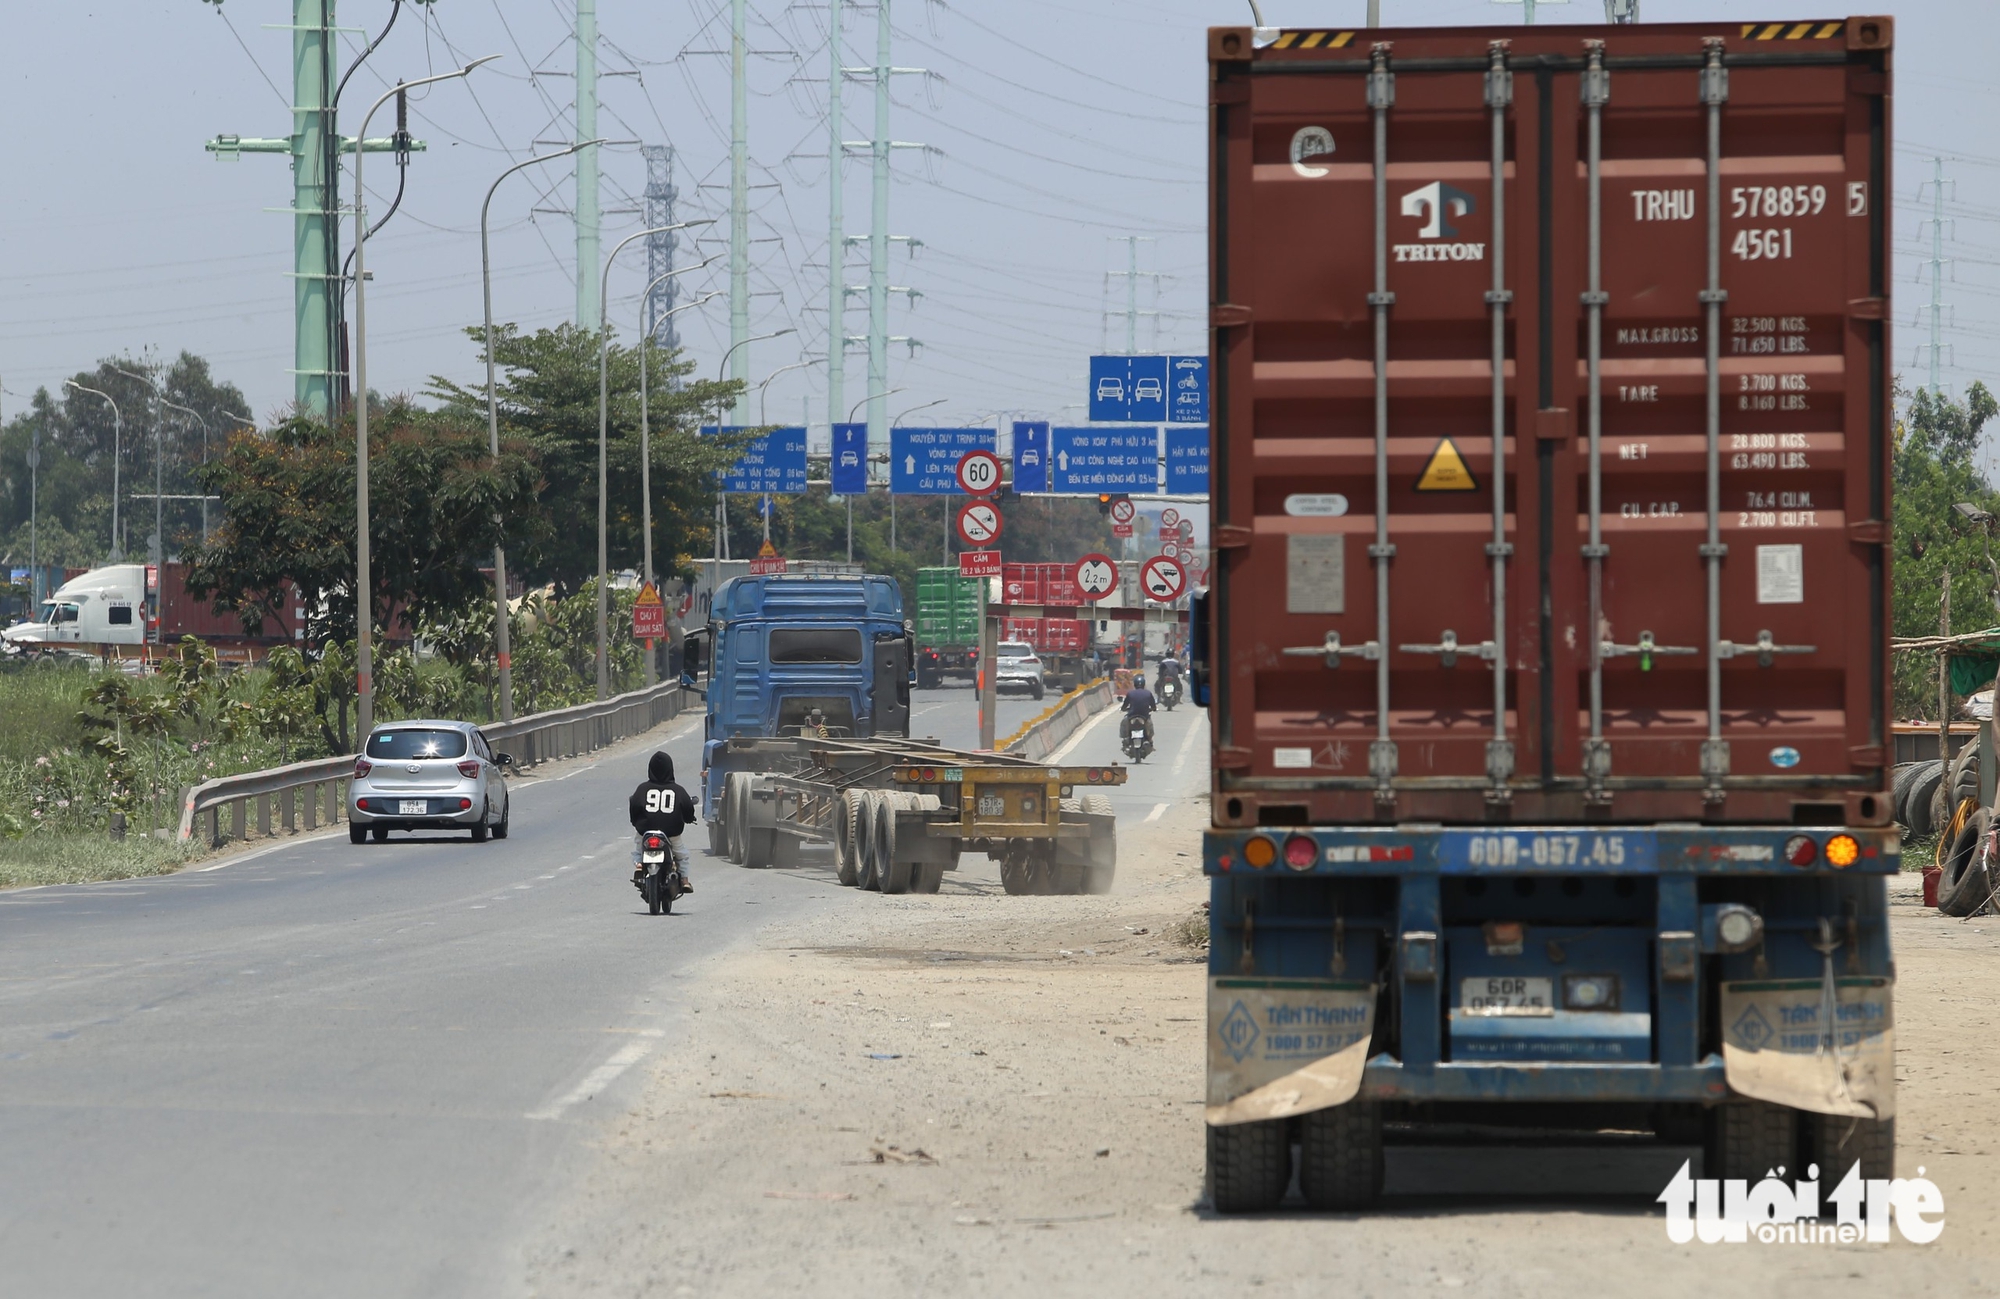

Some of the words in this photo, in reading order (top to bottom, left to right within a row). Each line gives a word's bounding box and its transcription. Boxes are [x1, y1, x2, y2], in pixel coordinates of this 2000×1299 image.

[1632, 188, 1695, 222] TRHU
[1730, 183, 1827, 217] 578859
[1847, 181, 1868, 217] 5
[1393, 243, 1486, 262] TRITON
[1732, 229, 1793, 260] 45G1
[1732, 317, 1776, 333] 32.500
[1617, 327, 1699, 345] MAX.GROSS
[1739, 374, 1776, 391] 3.700
[1781, 374, 1811, 391] KGS.
[1619, 385, 1659, 402] TARE
[939, 434, 952, 443] DUY
[1732, 433, 1776, 449] 28.800
[1781, 433, 1811, 449] KGS.
[1619, 443, 1649, 460] NET
[1072, 456, 1085, 465] KHU
[1127, 457, 1138, 465] CAO
[1732, 453, 1776, 470] 63.490
[1781, 453, 1811, 470] LBS.
[969, 463, 989, 482] 60
[1082, 475, 1089, 484] XE
[736, 481, 747, 490] MAI
[1739, 512, 1776, 527] 2.700
[973, 552, 988, 562] CẤM
[645, 789, 675, 813] 90
[1267, 1003, 1302, 1023] TÂN
